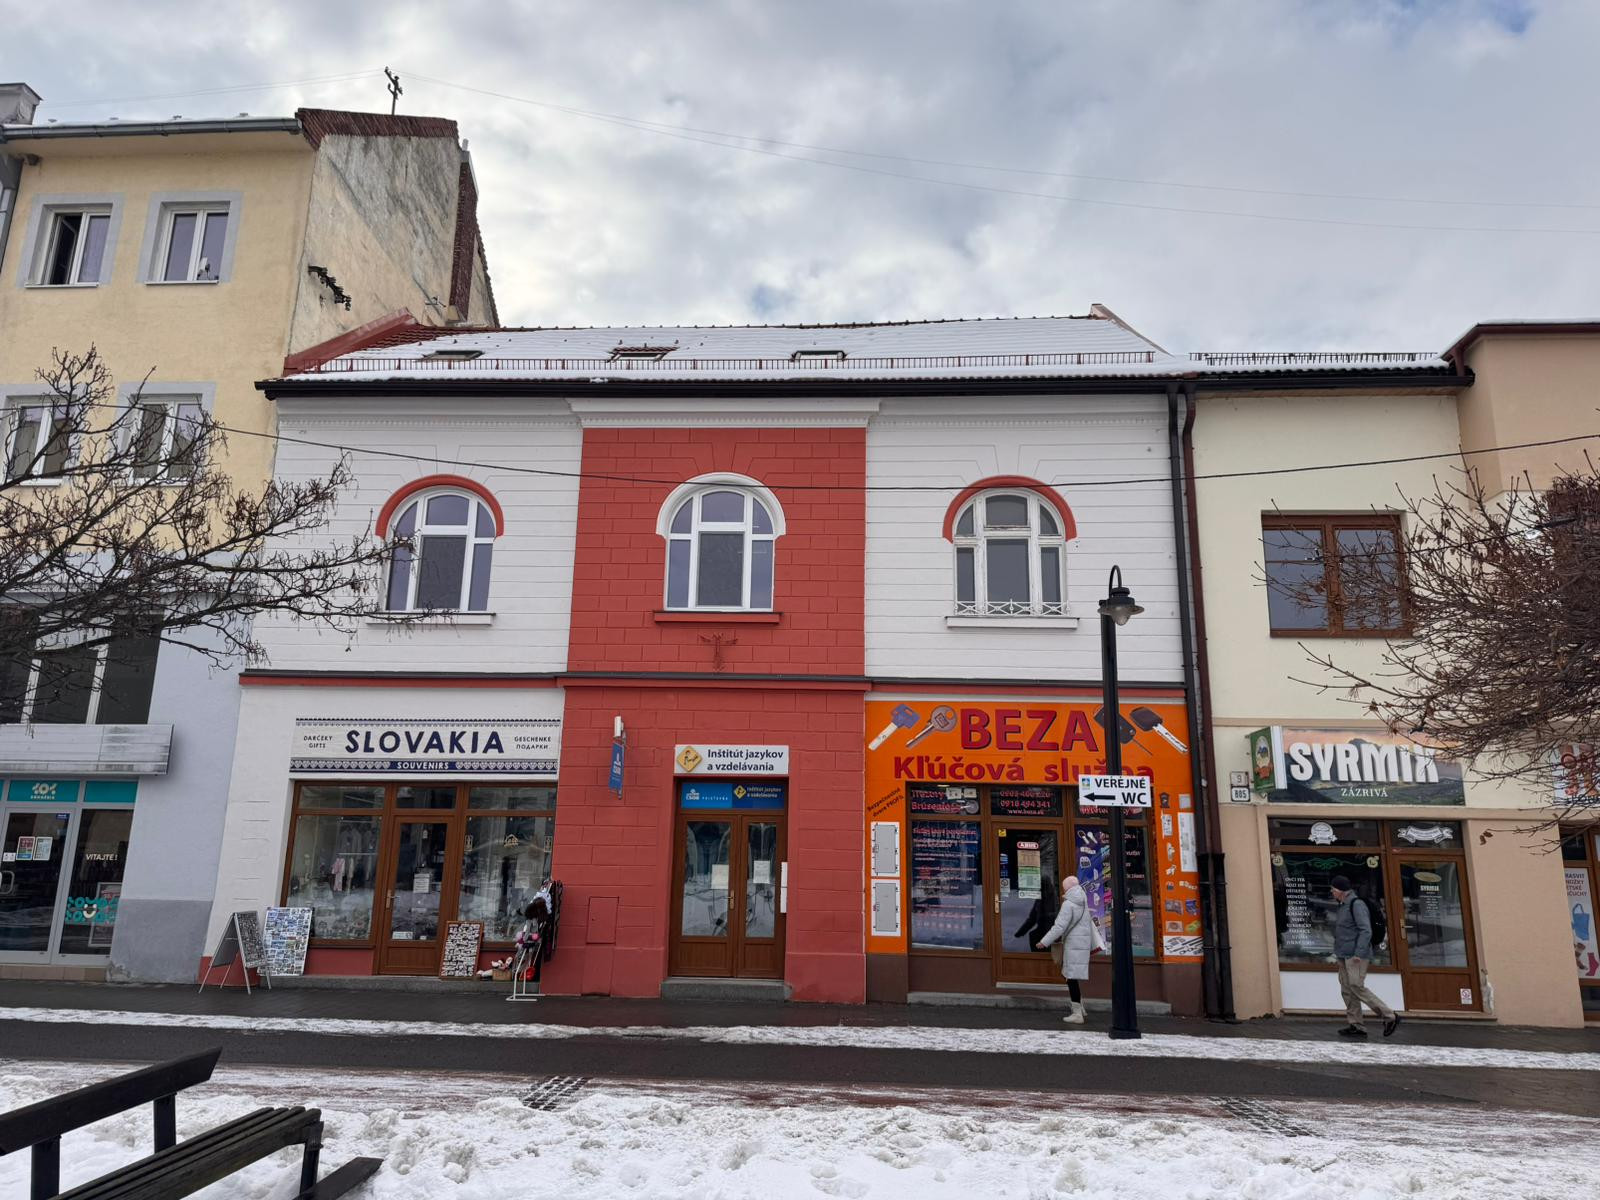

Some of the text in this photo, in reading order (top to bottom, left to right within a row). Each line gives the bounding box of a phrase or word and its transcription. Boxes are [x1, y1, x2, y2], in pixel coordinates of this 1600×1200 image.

[960, 708, 1099, 752] BEZA
[303, 734, 333, 742] DARČEKY
[345, 730, 504, 754] SLOVAKIA
[707, 749, 784, 760] Inštitút jazykov
[396, 761, 449, 770] SOUVENIRS
[707, 761, 774, 771] a vzdelávania
[1289, 742, 1439, 783] SYRMIX
[894, 755, 1154, 783] Kľúčová služa
[1094, 777, 1146, 789] VEREJNÉ
[1234, 789, 1247, 799] 885
[1341, 787, 1389, 798] ZÁZRIVÁ
[1121, 792, 1147, 805] WC
